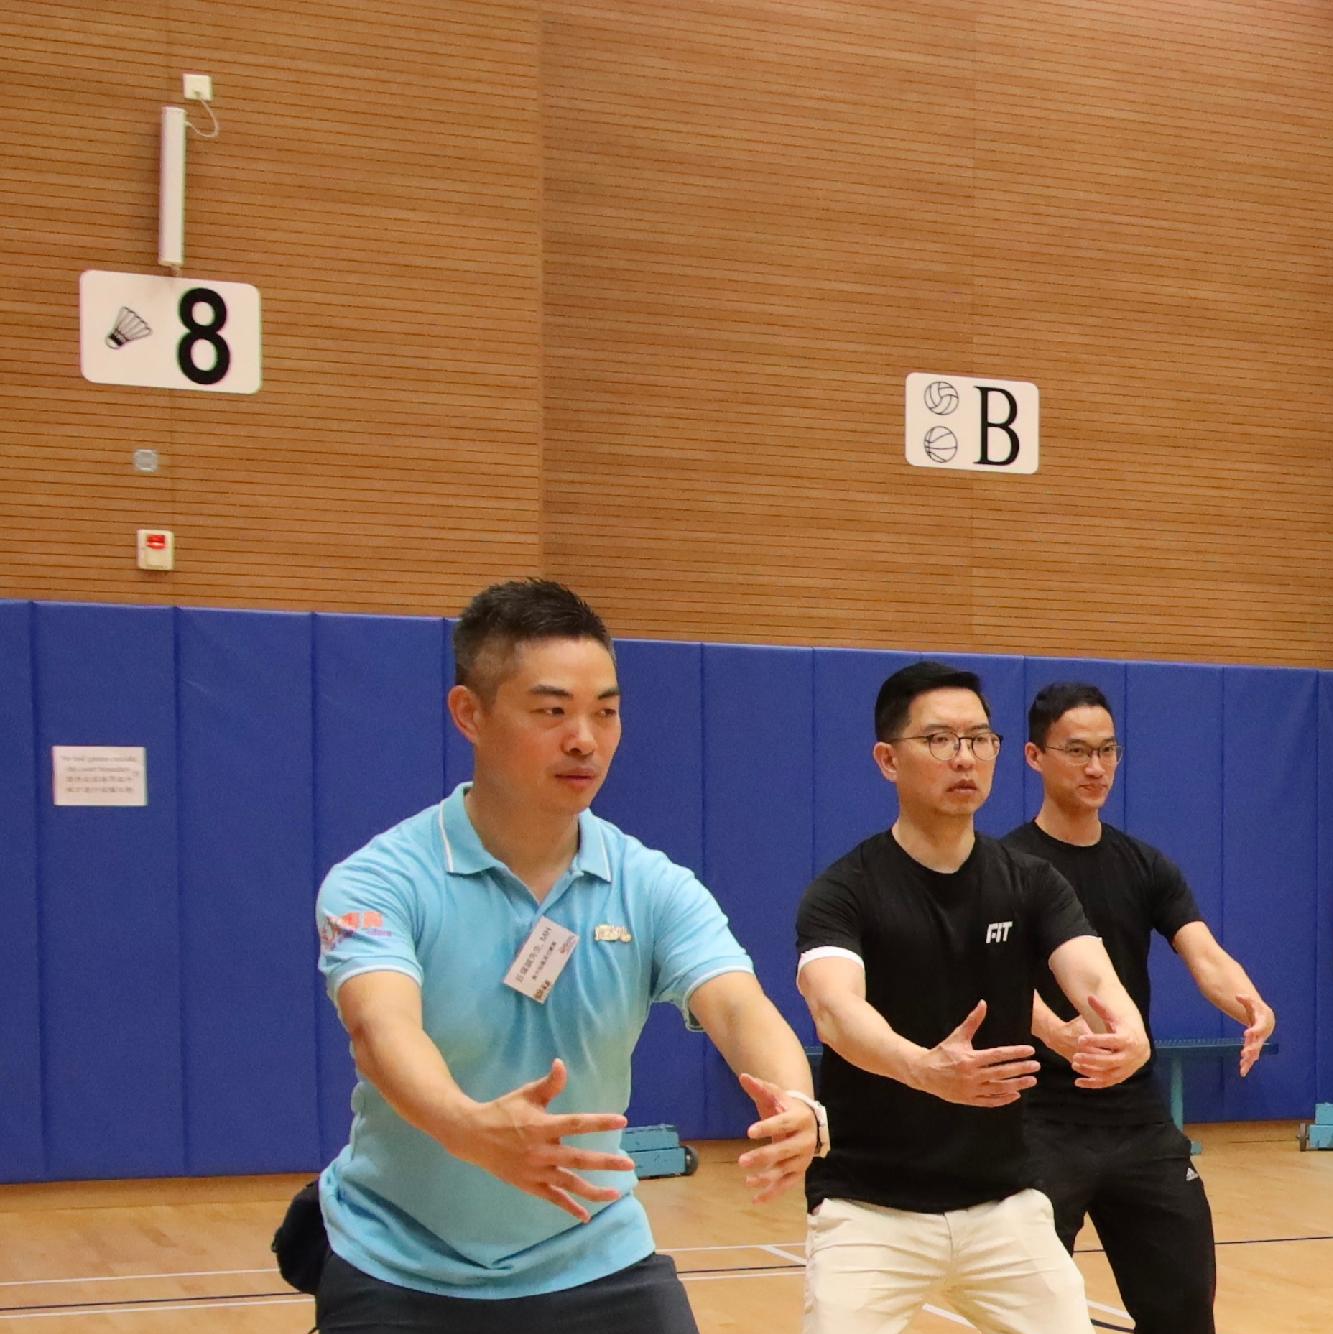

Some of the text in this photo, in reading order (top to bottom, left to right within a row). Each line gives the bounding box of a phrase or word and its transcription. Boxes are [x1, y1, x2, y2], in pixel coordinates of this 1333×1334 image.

[178, 286, 231, 385] 8
[973, 386, 1020, 467] B
[985, 920, 1013, 944] FIT
